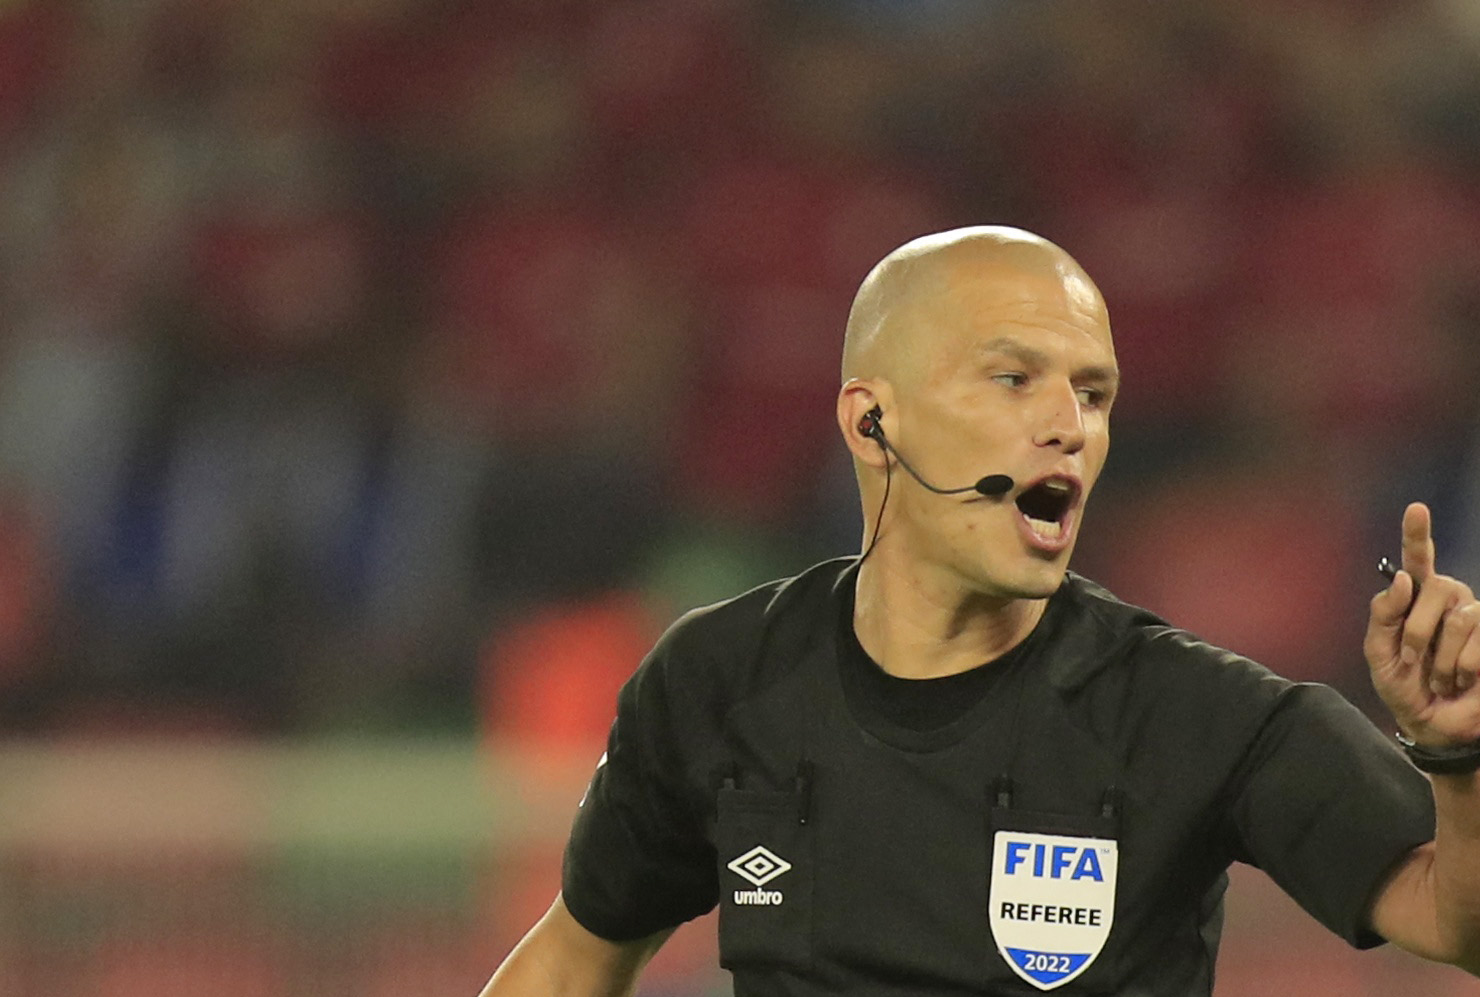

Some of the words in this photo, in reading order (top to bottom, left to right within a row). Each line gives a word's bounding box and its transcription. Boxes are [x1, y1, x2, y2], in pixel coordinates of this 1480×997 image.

[1004, 841, 1105, 883] FIFA
[733, 887, 784, 906] umbro
[1000, 901, 1102, 927] REFEREE
[1024, 952, 1071, 974] 2022
